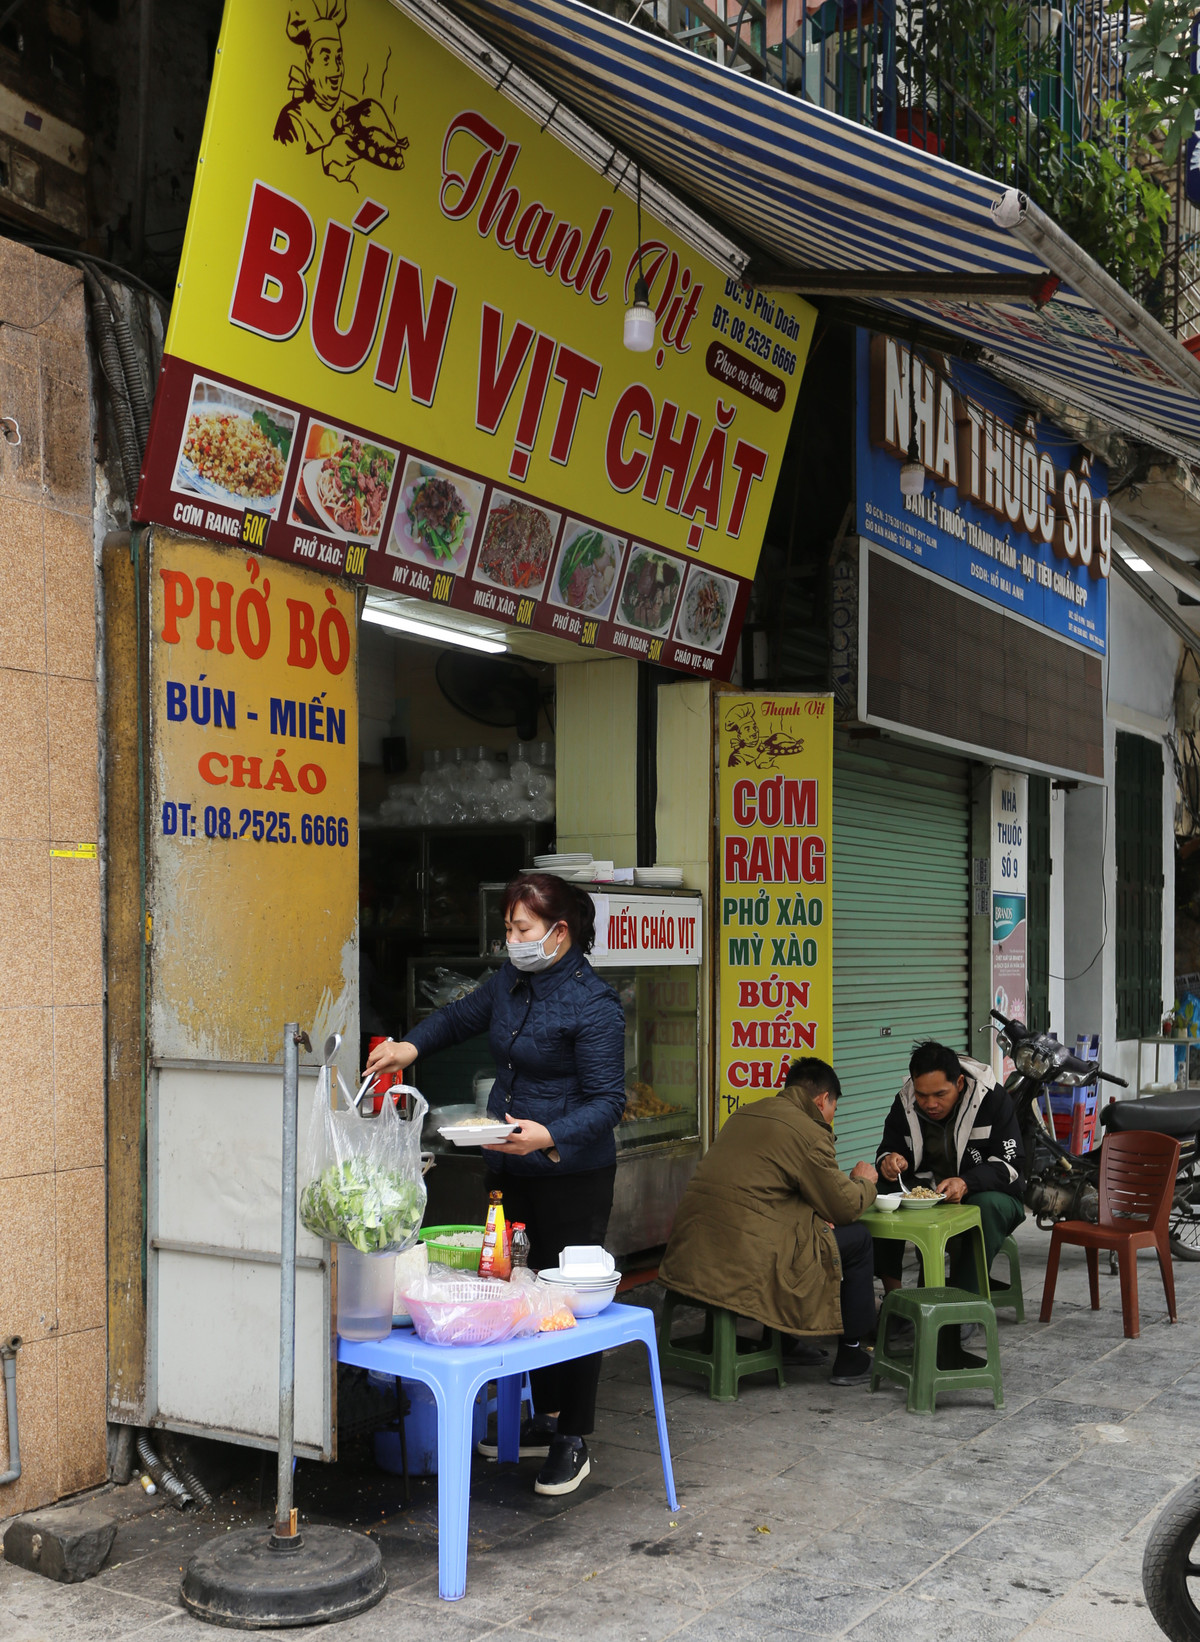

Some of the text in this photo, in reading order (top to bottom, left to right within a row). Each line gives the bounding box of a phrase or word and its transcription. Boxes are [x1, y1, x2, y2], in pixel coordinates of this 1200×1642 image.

[439, 110, 613, 304] Thanh
[753, 290, 775, 326] Phủ
[774, 307, 801, 342] Doãn
[712, 303, 798, 377] ĐT: 08 2525 6666
[228, 179, 769, 551] BÚN VỊT CHẶT
[713, 348, 781, 403] Phục vụ tận nơi
[884, 335, 1113, 579] NHÀ THUỐC SỐ 9
[173, 502, 268, 547] CƠM RANG: 50K
[293, 535, 368, 576] PHỞ XÀO: 60K
[926, 491, 938, 526] LẺ
[939, 506, 966, 538] THUỐC
[966, 521, 993, 557] THÀNH
[993, 535, 1017, 570] PHẨM
[1021, 554, 1036, 583] ĐẠT
[1053, 570, 1075, 601] CHUẨN
[1075, 585, 1088, 608] GPP
[392, 565, 453, 603] MỲ XÀO: 60K
[1000, 577, 1012, 595] MAI
[1012, 584, 1025, 601] ANH
[159, 557, 351, 676] PHỞ BÒ
[473, 589, 535, 625] MIẾN XÀO: 60K
[552, 612, 599, 646] PHỞ BÒ: 50K
[613, 630, 628, 648] BÚN
[674, 649, 691, 666] CHÁO
[166, 674, 237, 730] BÚN
[269, 692, 346, 745] MIẾN
[761, 700, 826, 719] Thanh Vịt
[197, 748, 328, 796] CHÁO
[161, 801, 197, 838] ĐT:
[732, 774, 818, 828] CƠM
[1001, 786, 1017, 813] NHÀ
[997, 818, 1022, 847] THUỐC
[724, 835, 827, 884] RANG
[1001, 849, 1012, 877] SỐ
[1013, 858, 1018, 879] 9
[723, 888, 824, 927] PHỞ XÀO
[641, 909, 675, 950] CHÁO
[678, 916, 696, 955] VỊT
[728, 932, 818, 968] MỲ XÀO
[737, 973, 811, 1010] BÚN
[731, 1009, 819, 1050] MIẾN
[727, 1054, 791, 1089] CHÁ
